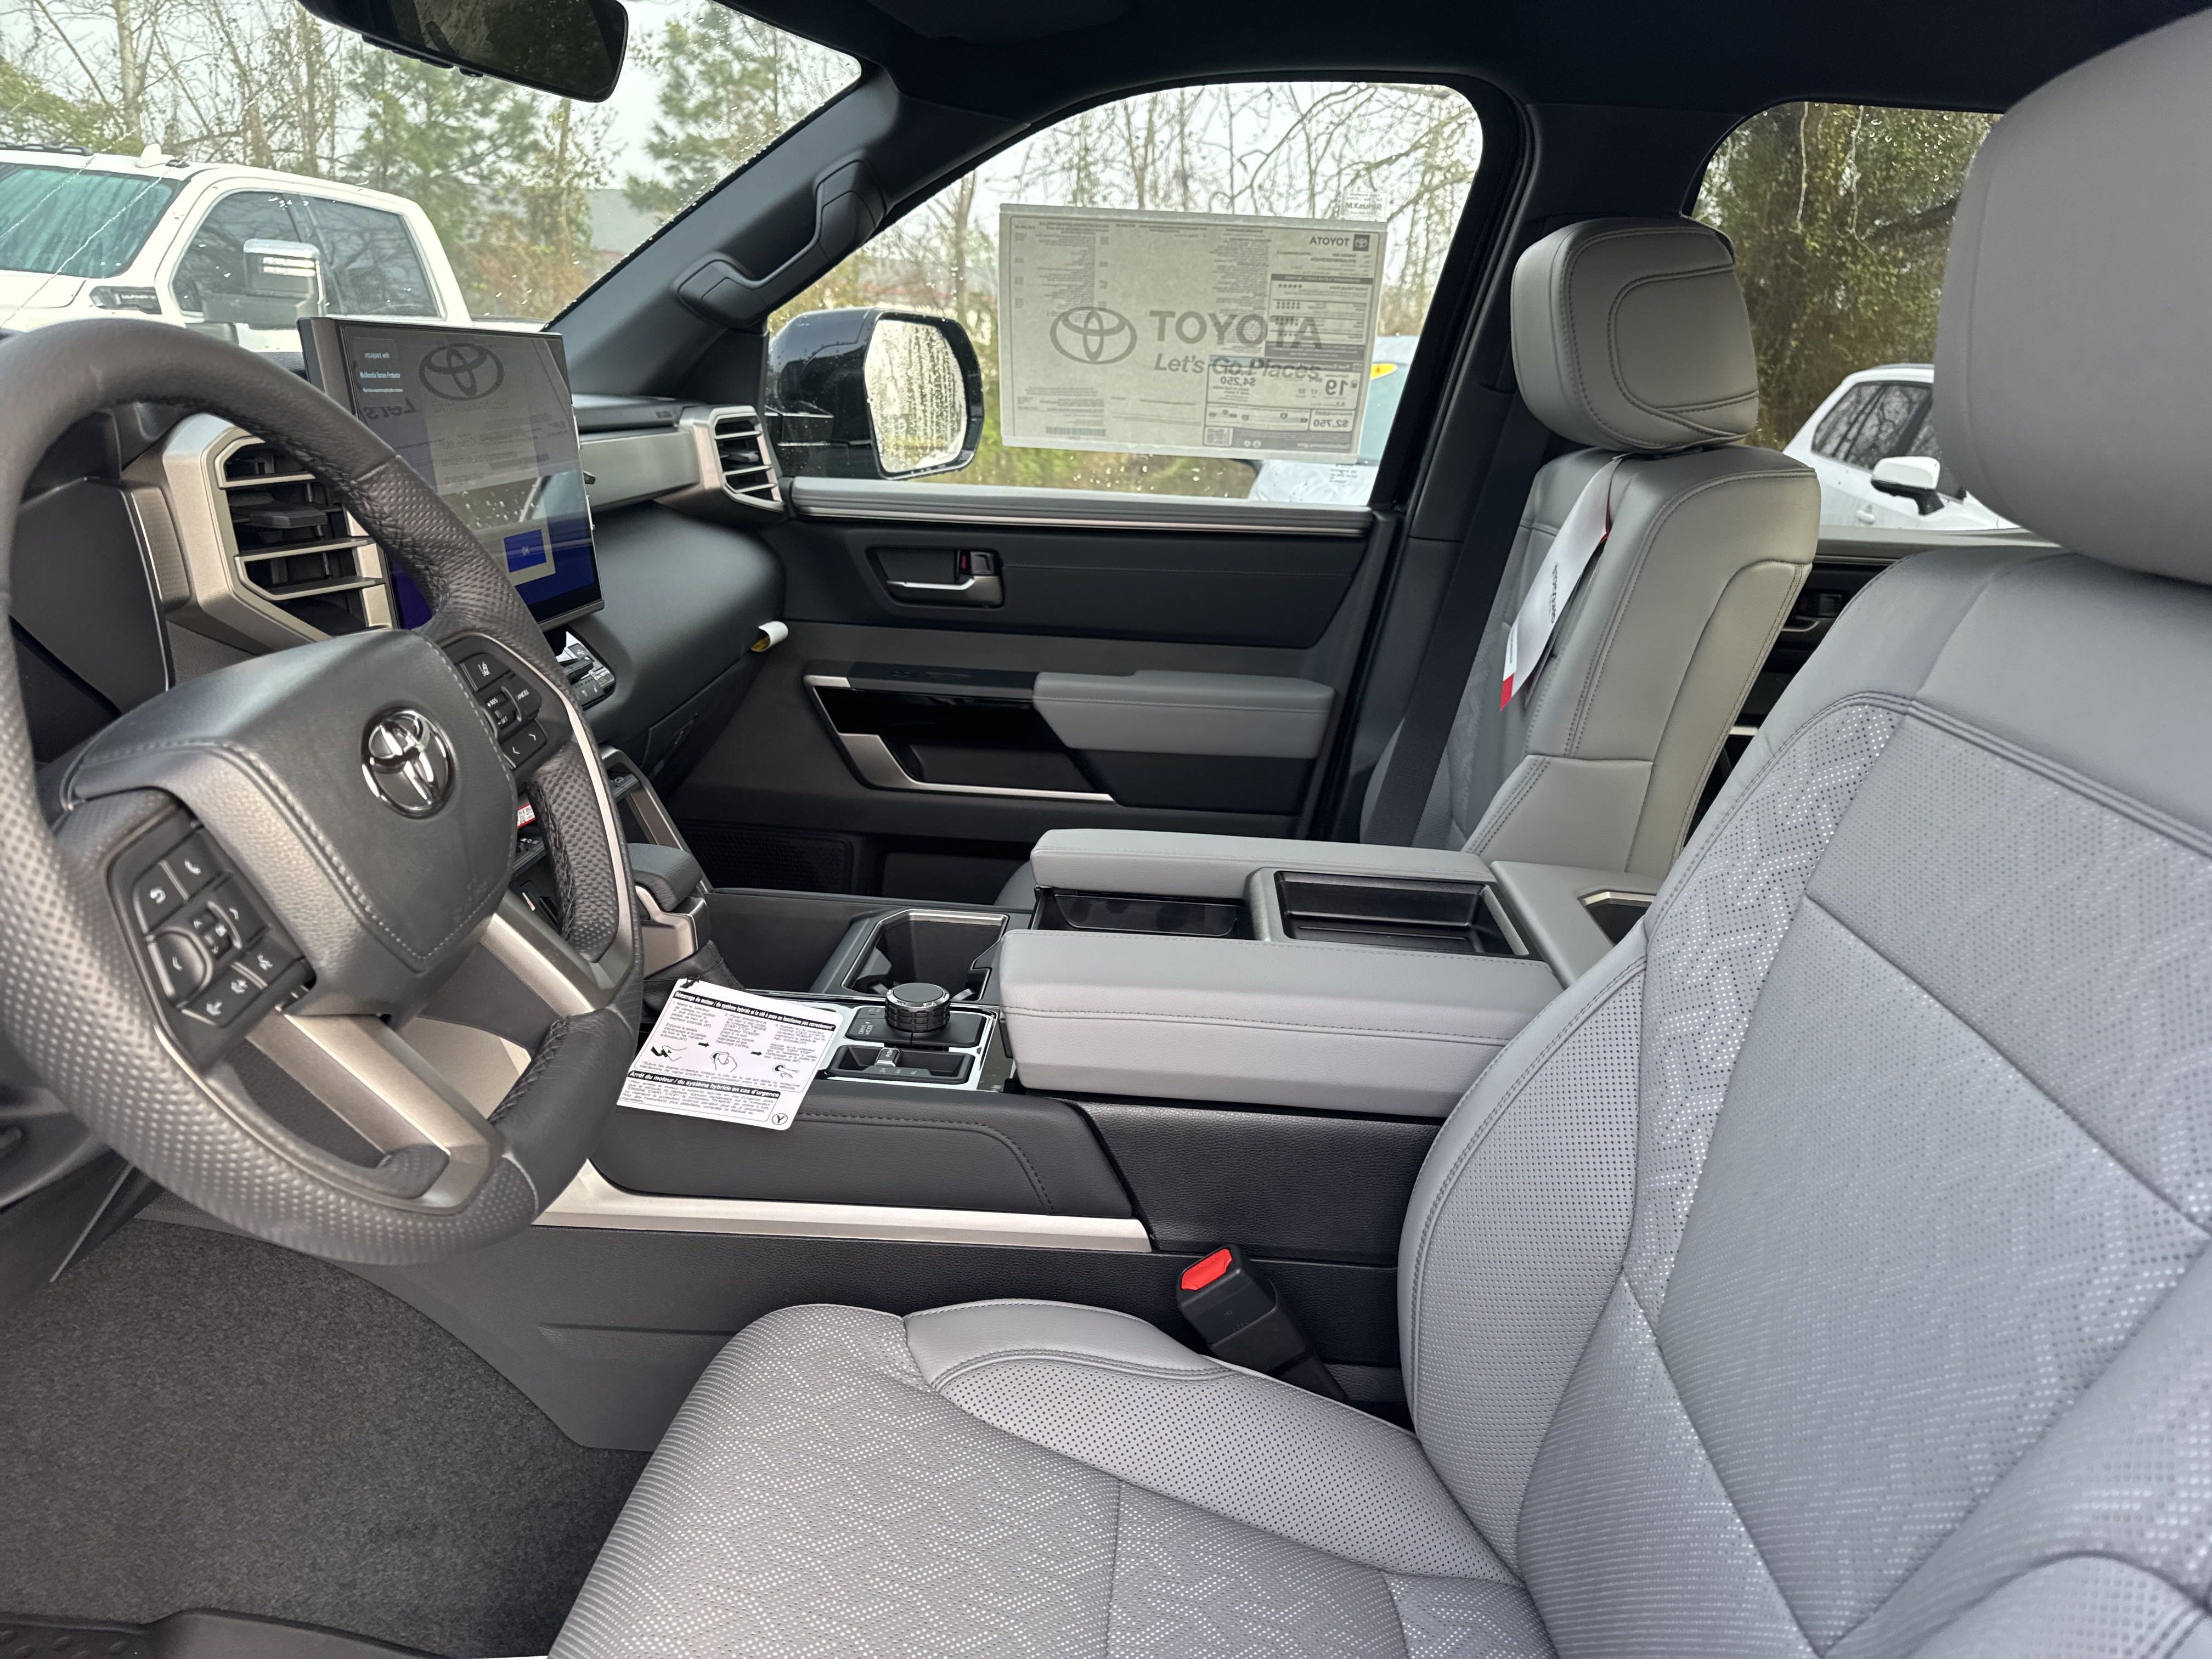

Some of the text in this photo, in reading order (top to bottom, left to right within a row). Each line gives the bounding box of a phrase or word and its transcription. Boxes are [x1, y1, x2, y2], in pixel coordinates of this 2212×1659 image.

[1149, 310, 1323, 349] TOYOTA
[1154, 353, 1320, 380] Let's Go Places
[777, 1115, 785, 1124] Y
